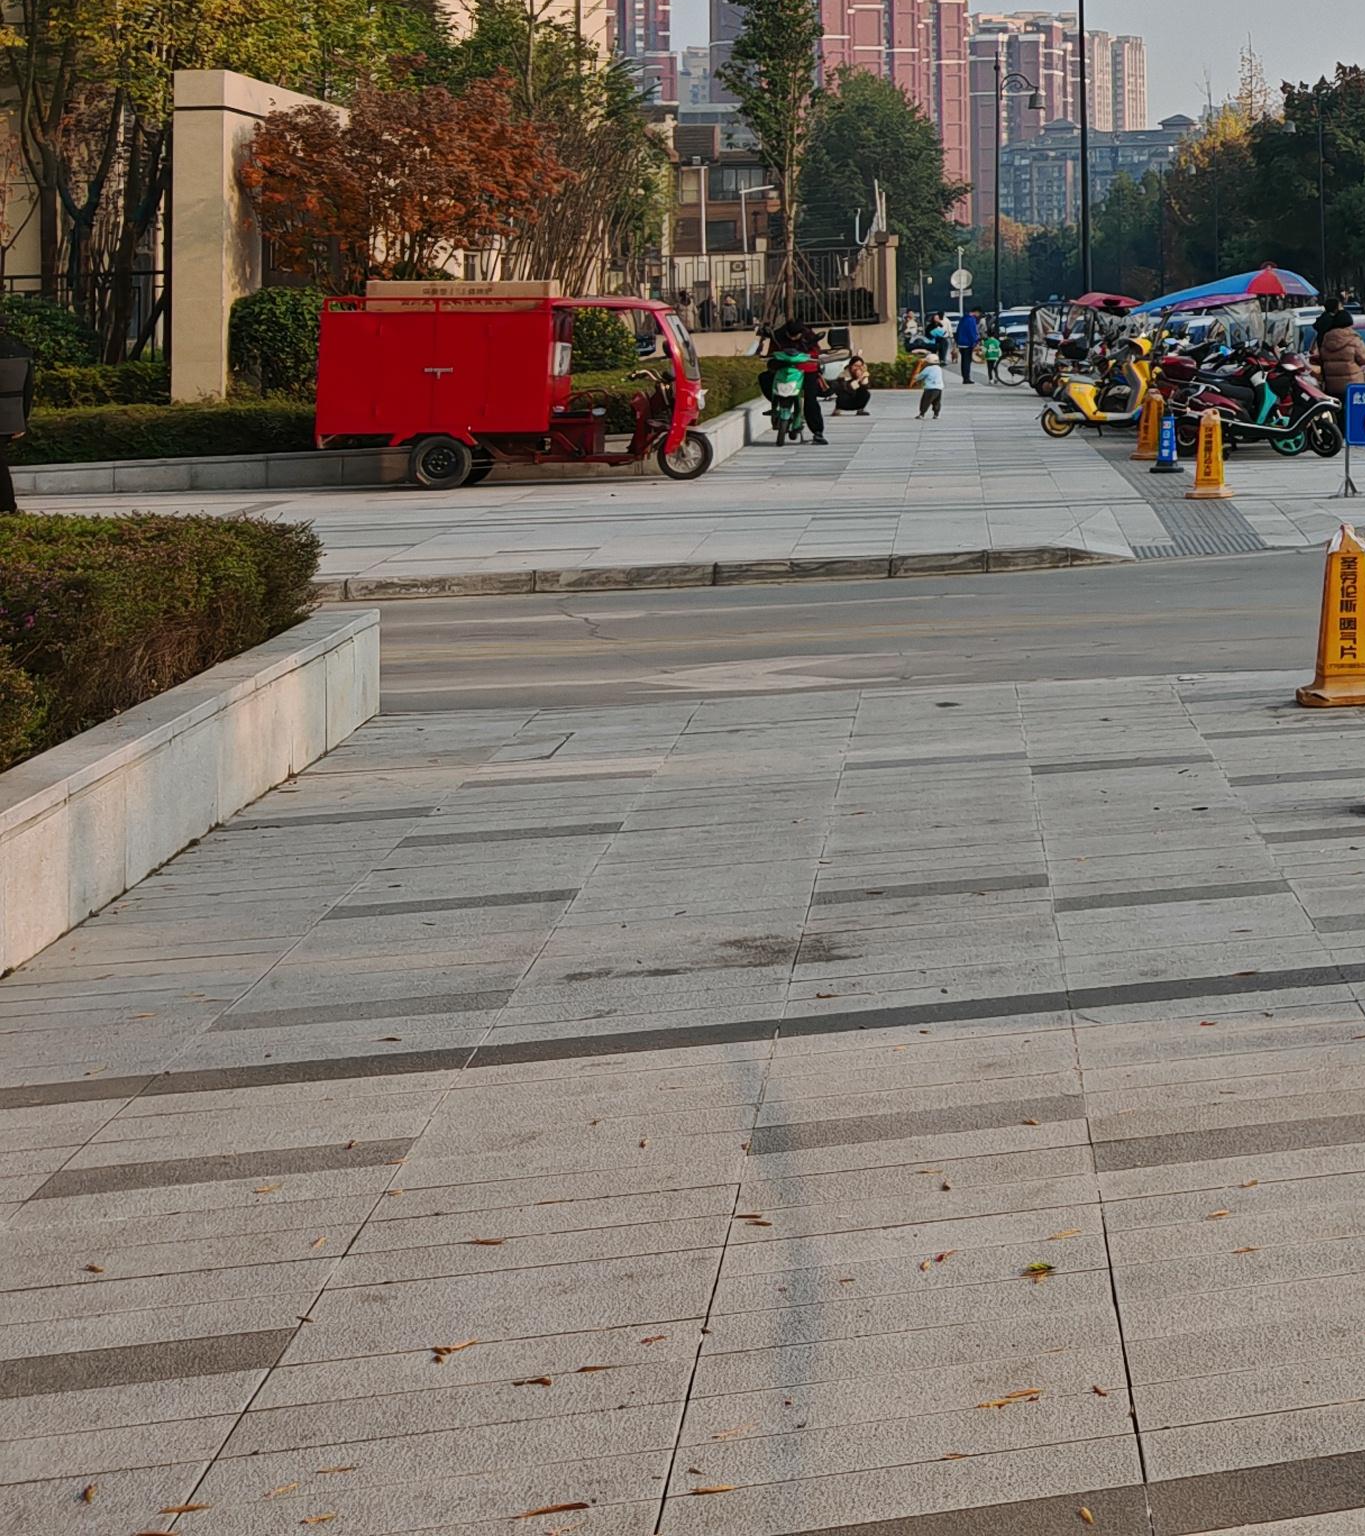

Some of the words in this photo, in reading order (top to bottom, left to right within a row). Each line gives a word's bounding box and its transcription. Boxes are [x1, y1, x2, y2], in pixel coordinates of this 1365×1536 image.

[1340, 556, 1358, 613] 圣劳伦斯
[1339, 617, 1357, 659] 暖气片
